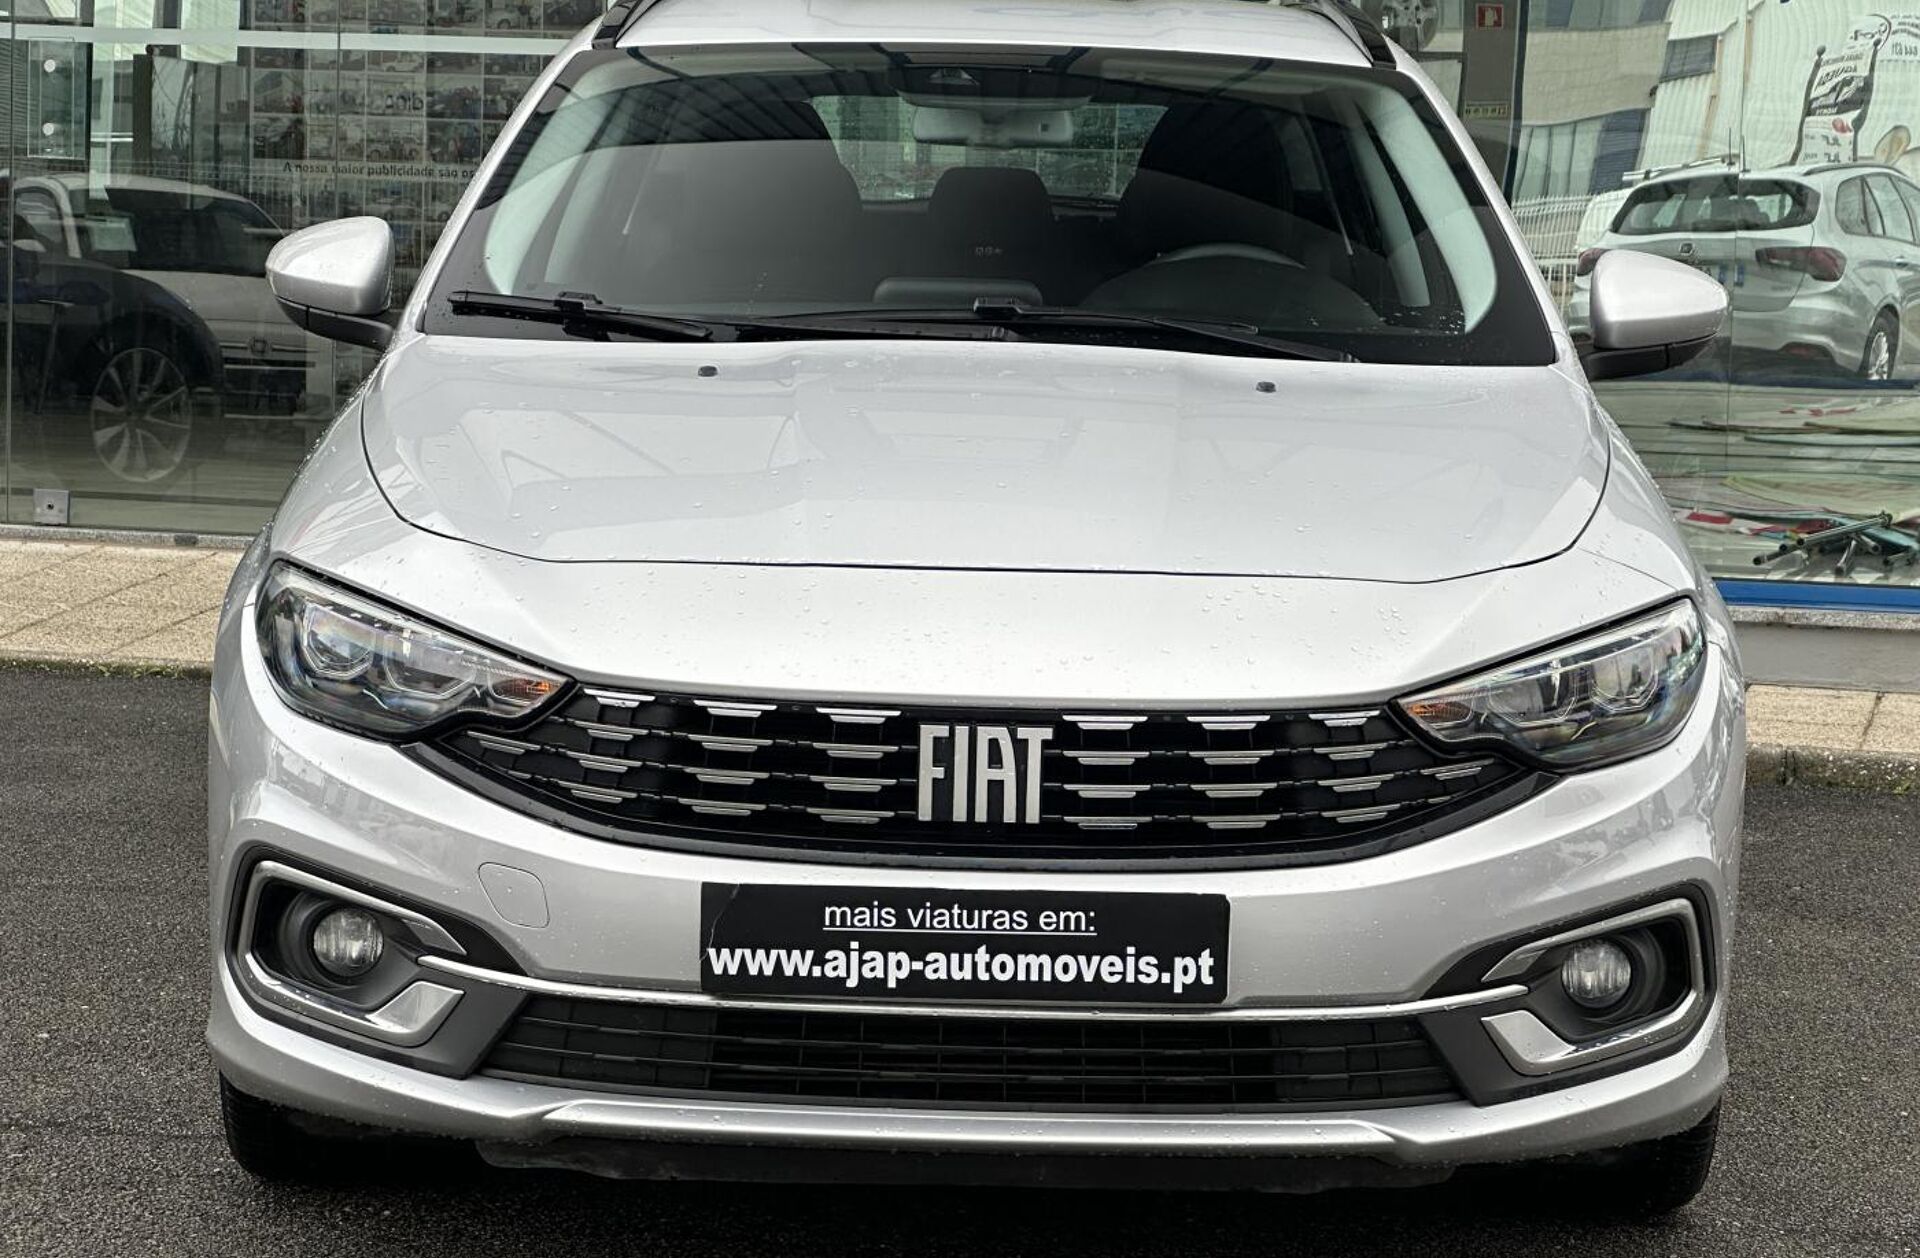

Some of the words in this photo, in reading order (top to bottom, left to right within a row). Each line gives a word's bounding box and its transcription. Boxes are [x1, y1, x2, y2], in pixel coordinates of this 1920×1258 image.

[282, 161, 292, 172] A
[295, 163, 328, 173] nossa
[367, 164, 434, 177] publicidade
[918, 724, 1054, 824] FIAT
[824, 900, 897, 928] mais
[906, 902, 1029, 931] viaturas
[1038, 909, 1096, 932] em:
[706, 941, 1215, 994] www.ajap-automoveis.pt
